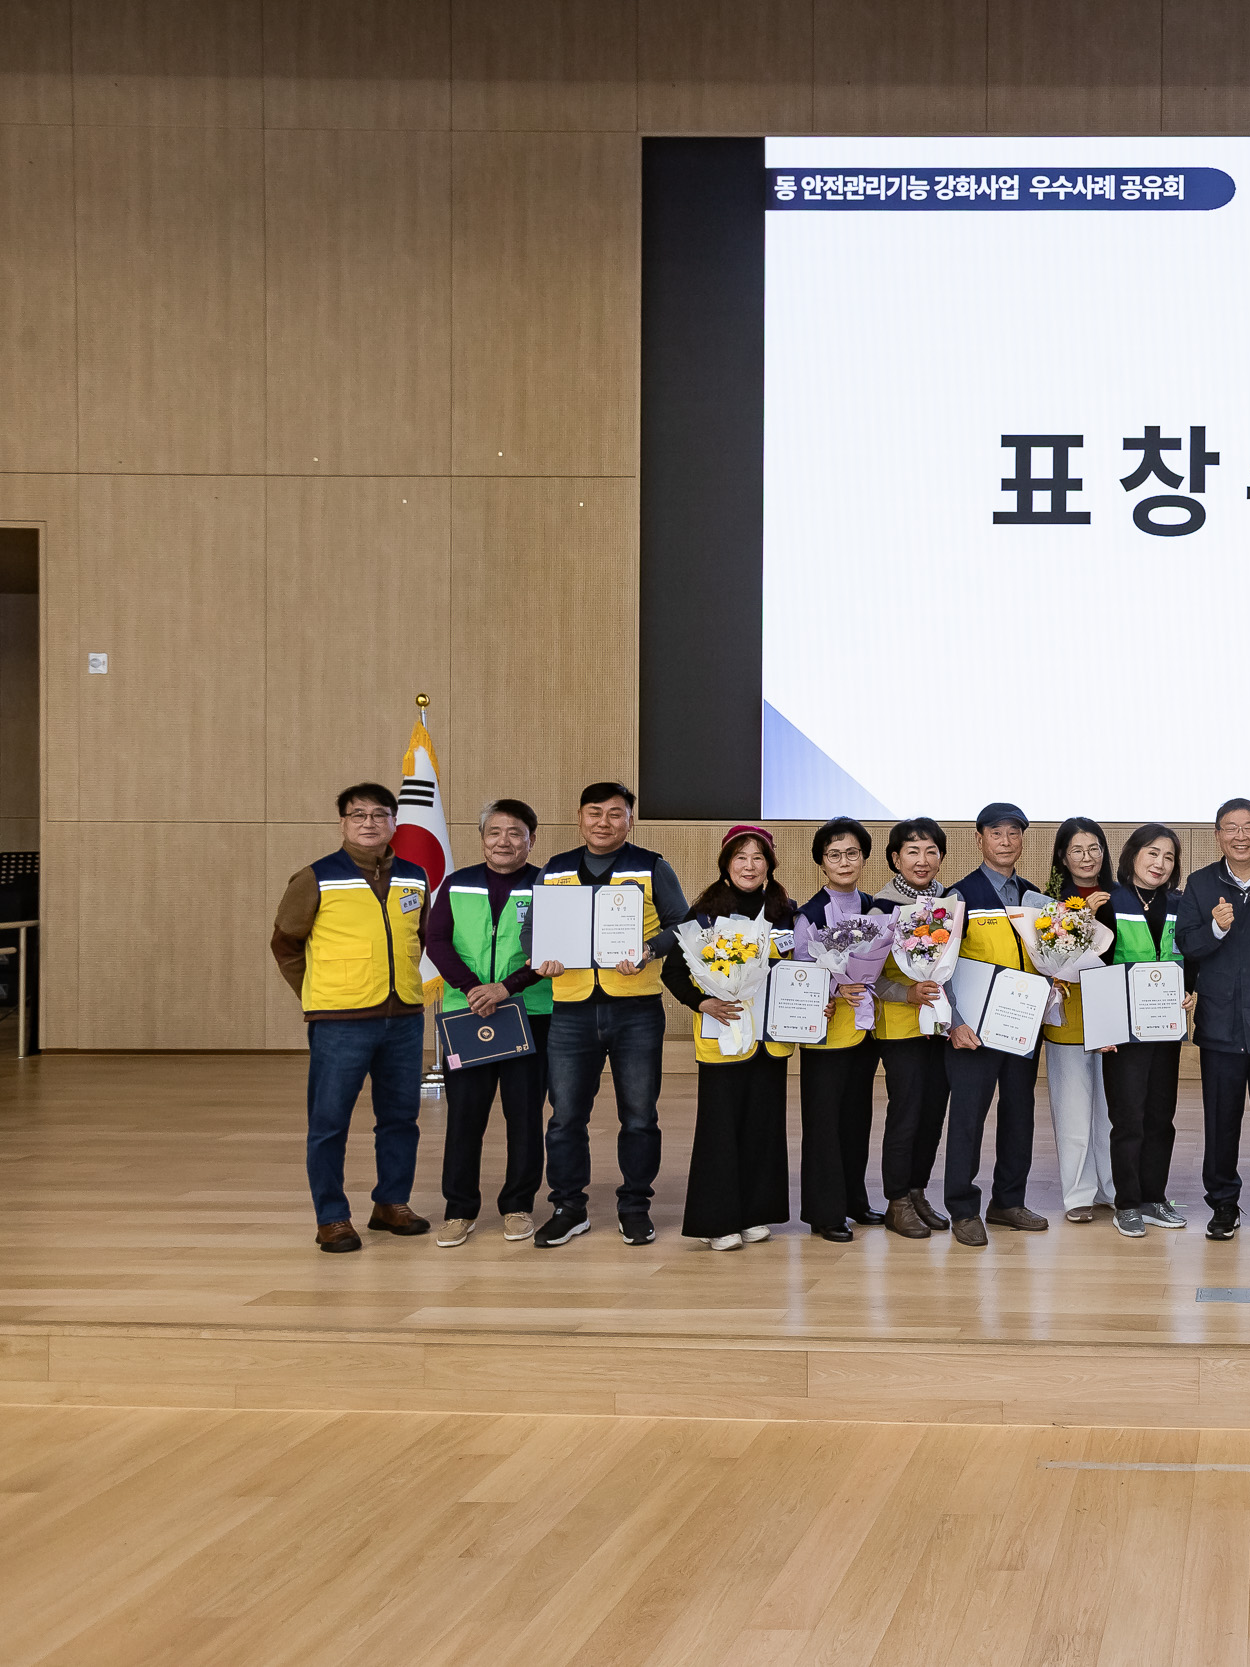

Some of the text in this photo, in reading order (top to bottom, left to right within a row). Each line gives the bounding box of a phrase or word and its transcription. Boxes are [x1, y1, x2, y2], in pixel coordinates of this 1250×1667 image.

[774, 174, 1185, 201] 동 안전관리기능 강화사업 우수사례 공유회
